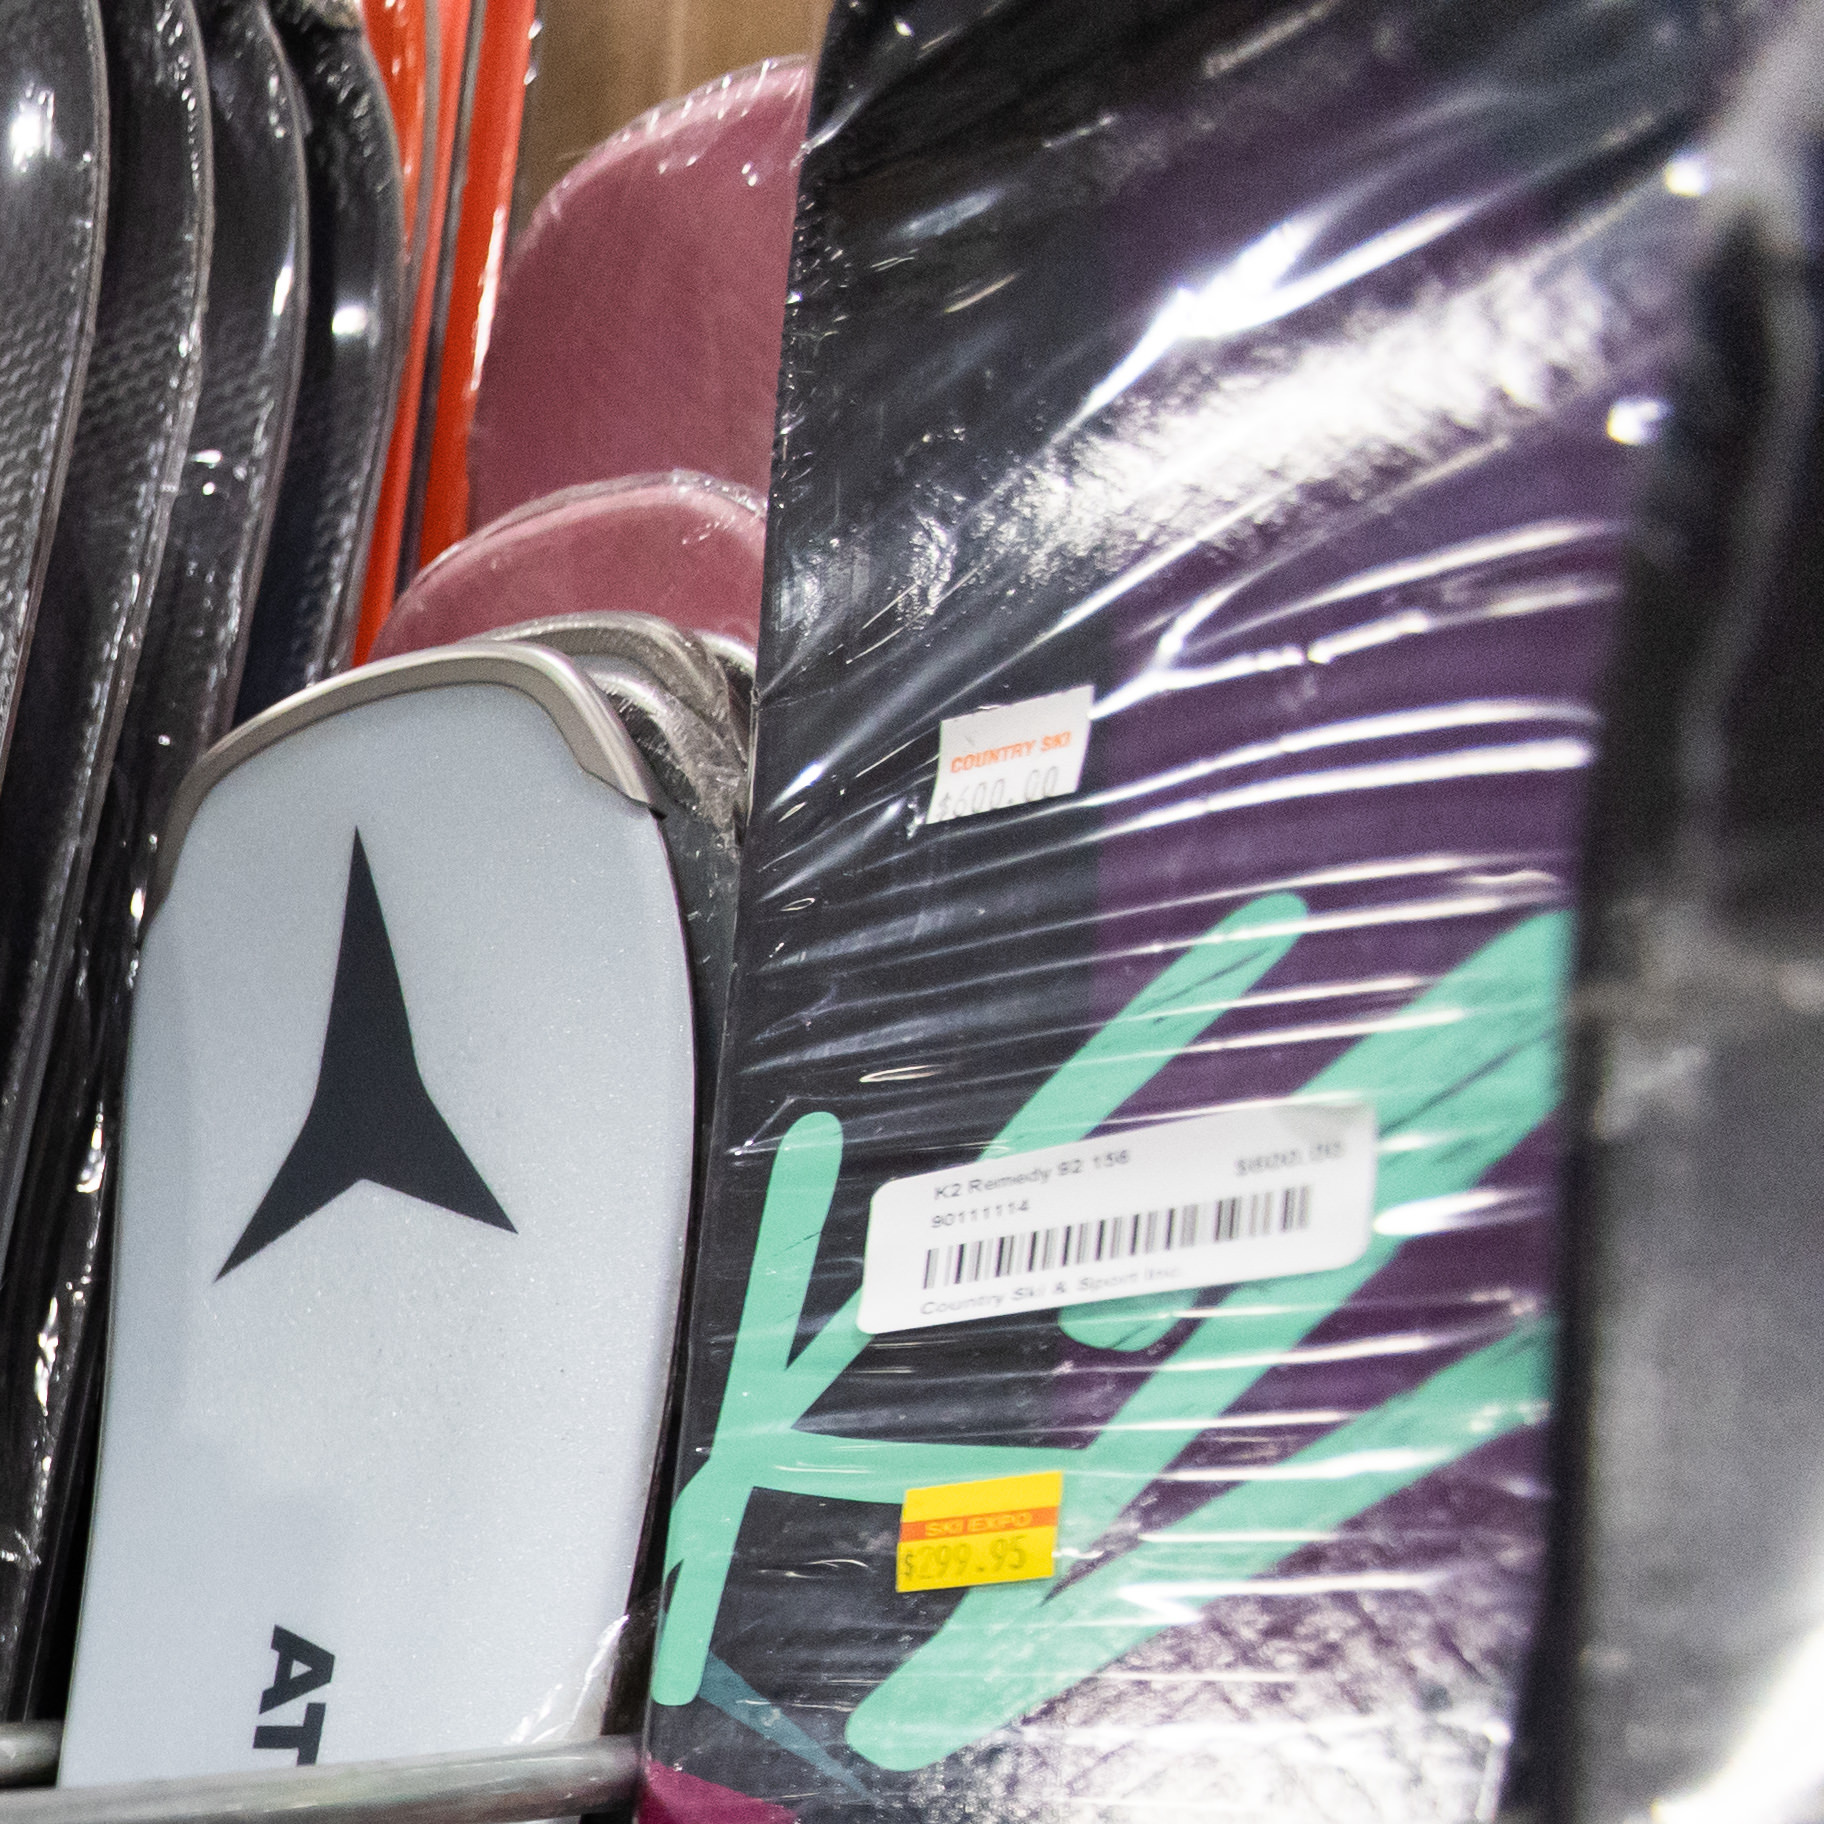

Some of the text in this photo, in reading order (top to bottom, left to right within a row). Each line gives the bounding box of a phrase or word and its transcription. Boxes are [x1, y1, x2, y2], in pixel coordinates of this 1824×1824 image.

[951, 730, 1072, 773] COUNTRY SKI
[935, 766, 1059, 821] $600.00
[934, 1182, 962, 1200] K2
[968, 1168, 1052, 1194] Remedy
[919, 1294, 1003, 1316] Country
[924, 1511, 1034, 1538] SKI EXPO
[903, 1535, 1029, 1582] $299.95
